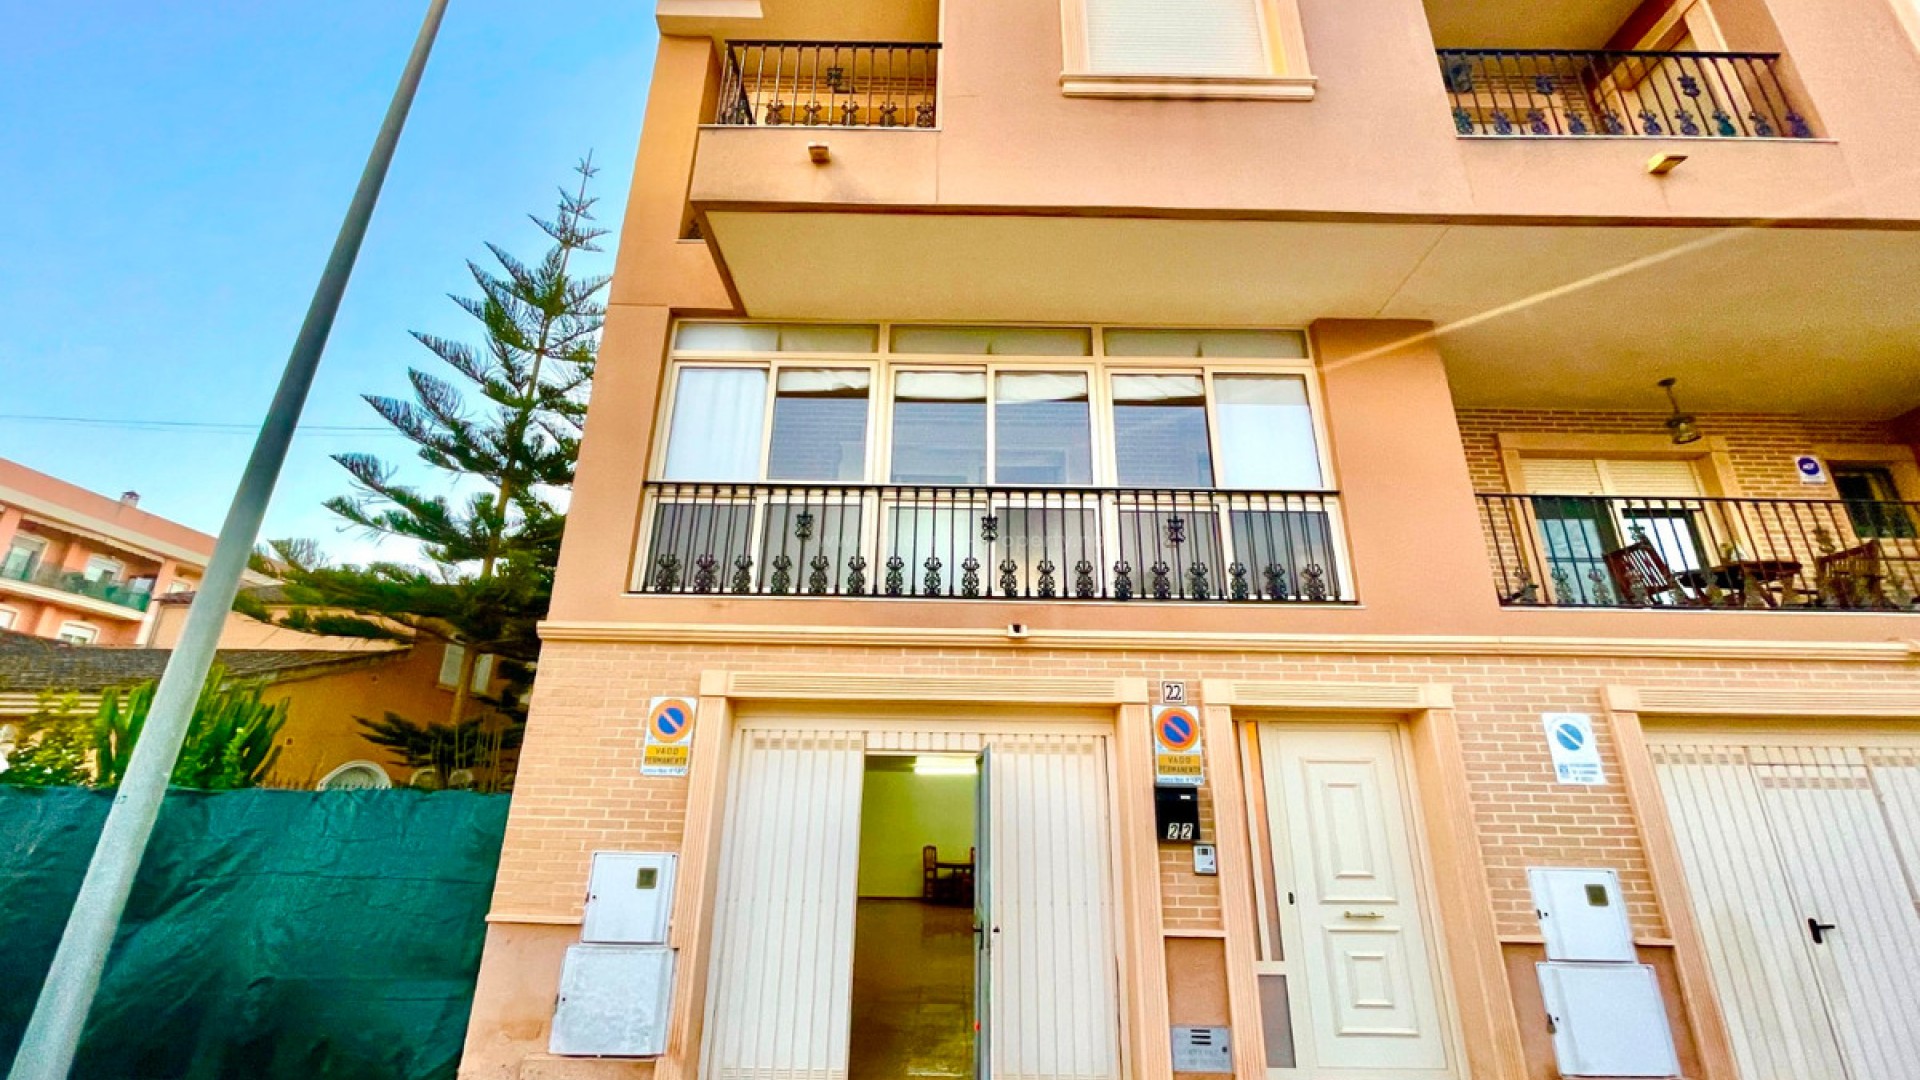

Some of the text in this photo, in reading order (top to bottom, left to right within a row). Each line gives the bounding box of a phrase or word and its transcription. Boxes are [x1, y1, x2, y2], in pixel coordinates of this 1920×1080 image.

[1165, 685, 1181, 700] 22
[655, 747, 679, 755] VADO
[1168, 756, 1191, 764] VADO
